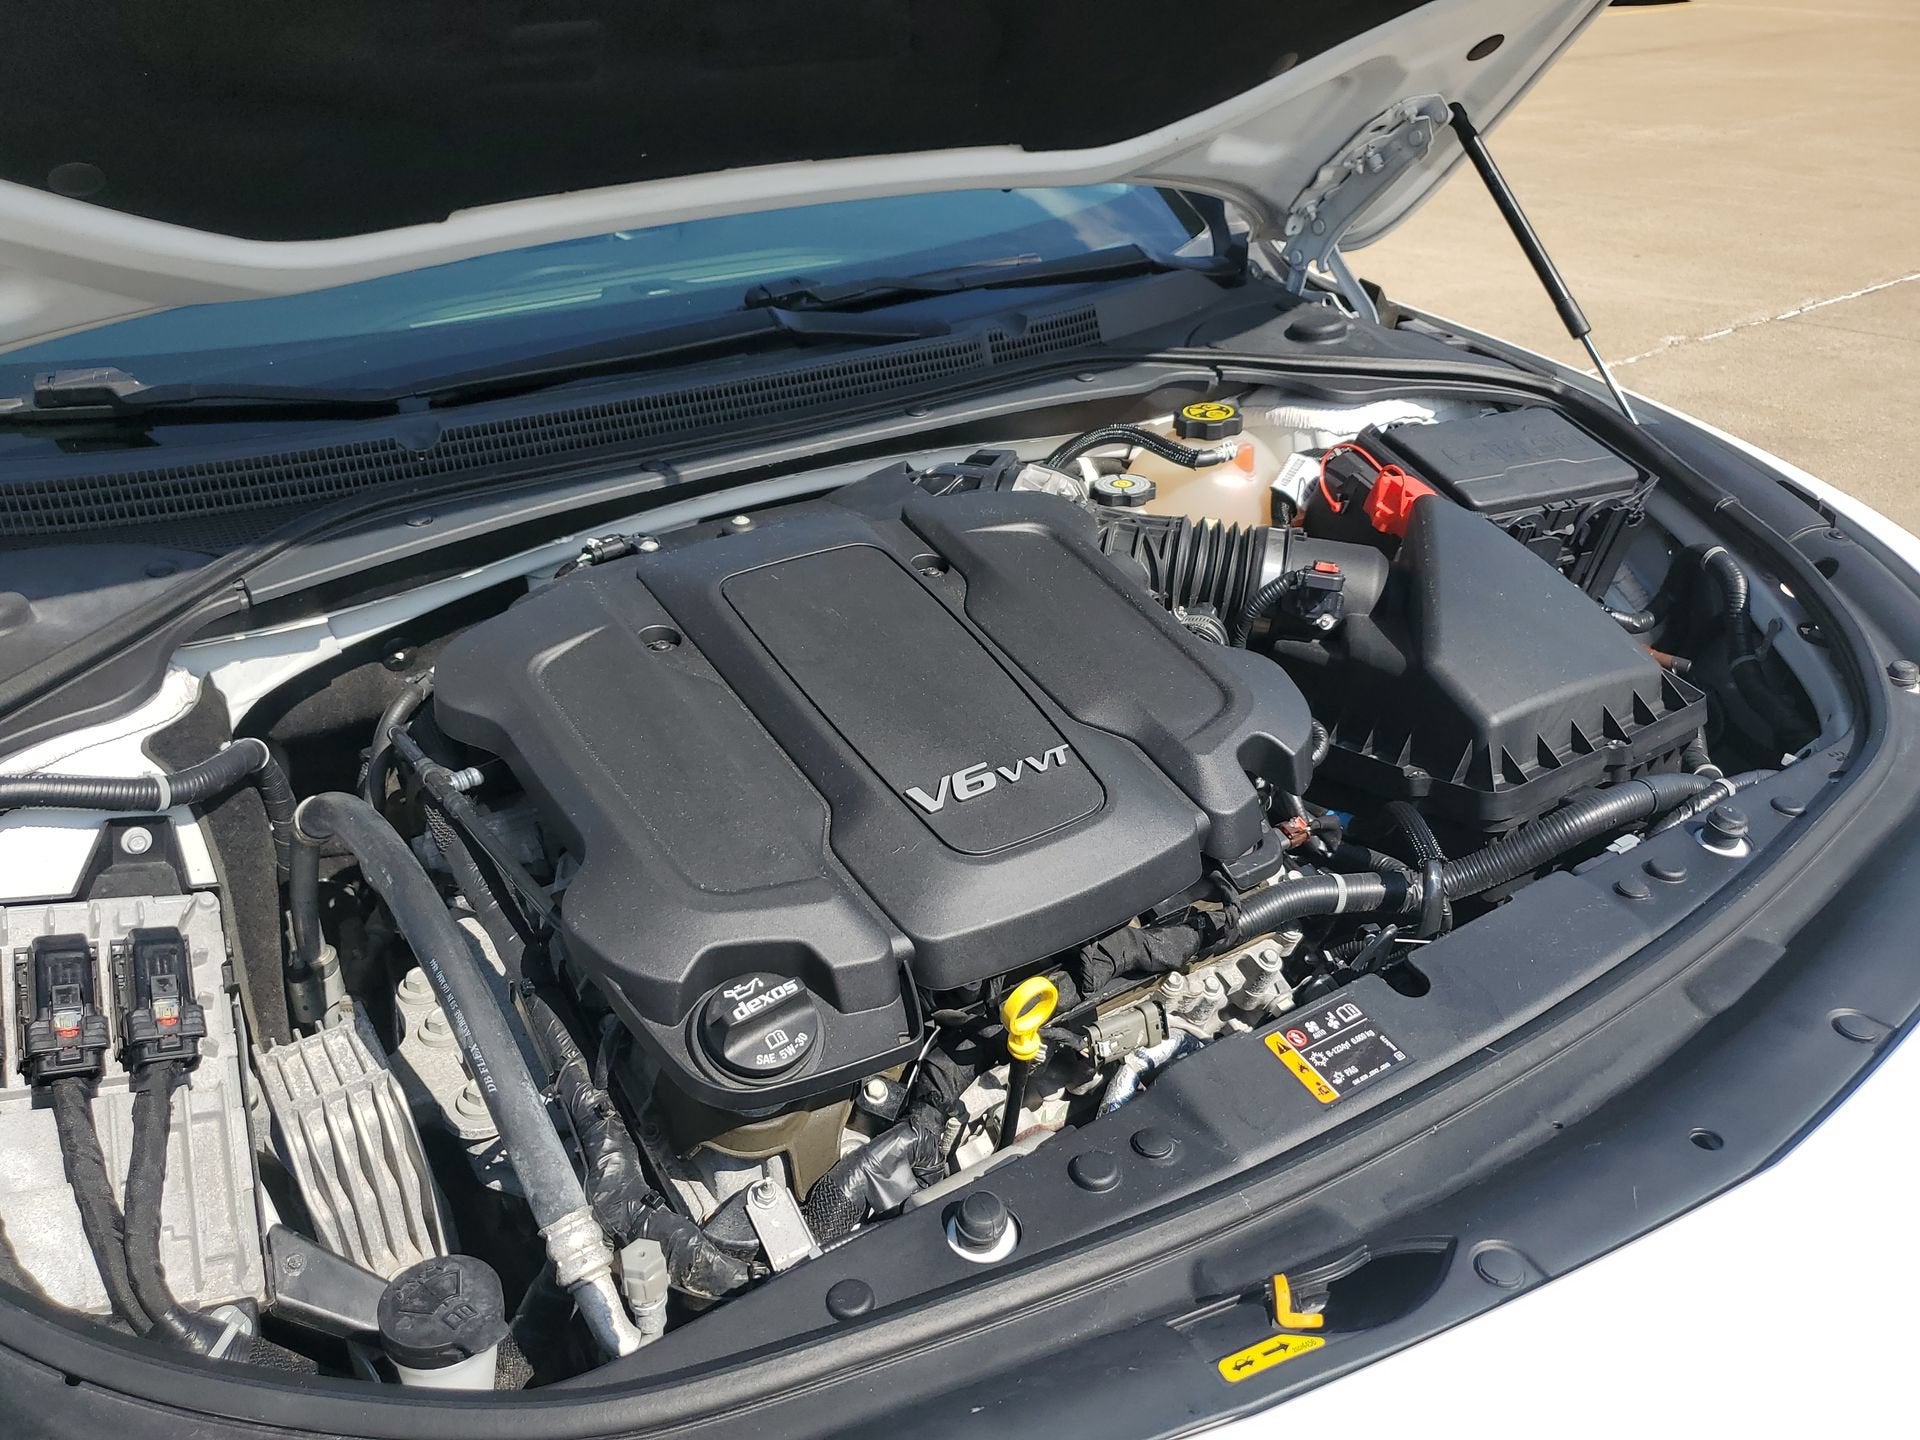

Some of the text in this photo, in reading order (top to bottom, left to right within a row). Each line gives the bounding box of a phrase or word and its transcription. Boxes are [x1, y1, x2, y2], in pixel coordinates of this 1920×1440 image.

[904, 743, 1069, 814] V6 VVT
[732, 979, 799, 1021] dexos
[470, 1042, 489, 1074] FLEX
[756, 1032, 808, 1065] SAE 5W-30
[484, 1075, 498, 1093] DB
[1343, 1065, 1359, 1077] PAG
